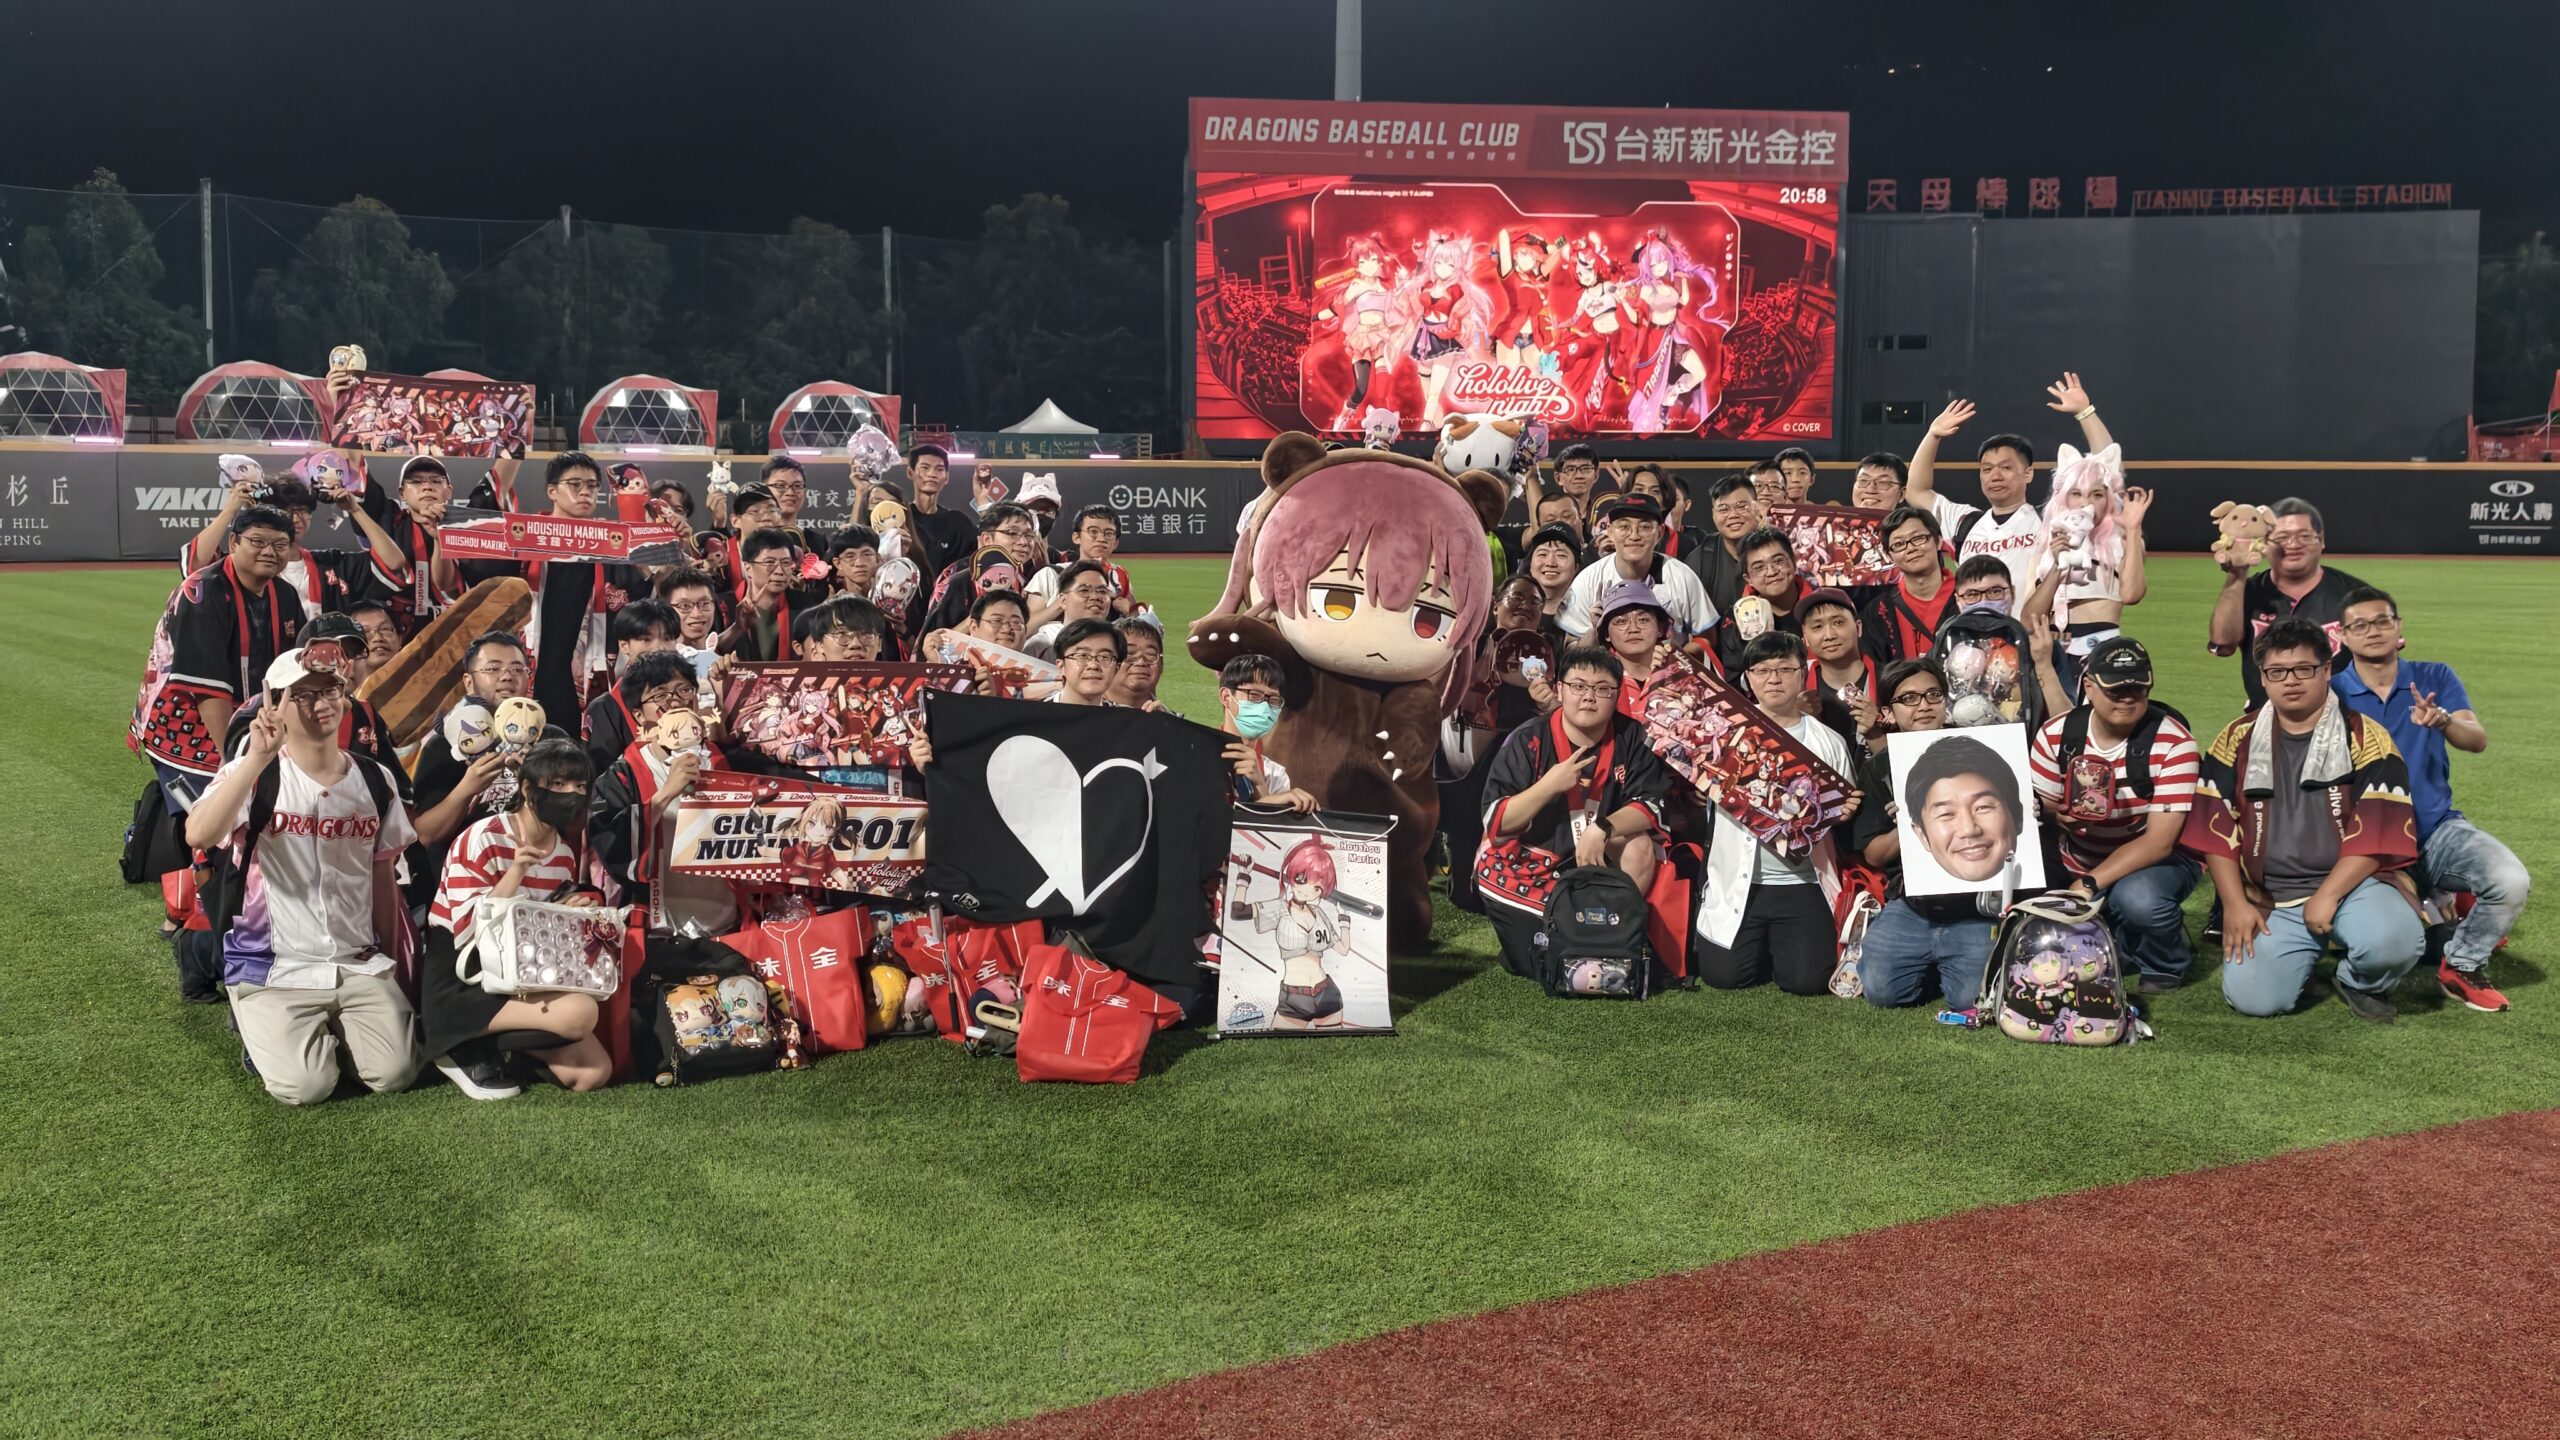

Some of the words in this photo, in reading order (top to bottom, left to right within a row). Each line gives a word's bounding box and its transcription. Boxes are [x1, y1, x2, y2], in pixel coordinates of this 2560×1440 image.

[1204, 116, 1320, 142] DRAGONS
[1328, 119, 1449, 146] BASEBALL
[1458, 122, 1521, 147] CLUB
[1614, 126, 1837, 166] 台新新光金控
[1779, 188, 1828, 204] 20:58
[2133, 189, 2214, 210] TIANMU
[2223, 186, 2340, 208] BASEBALL
[2355, 183, 2453, 205] STADIUM
[1454, 364, 1554, 395] hololive
[1488, 387, 1569, 416] night
[1791, 423, 1821, 433] COVER
[6, 475, 70, 507] 杉丘
[2470, 502, 2553, 521] 新光人壽
[12, 518, 49, 529] HILL
[159, 517, 200, 528] TAKE
[526, 521, 572, 538] HOUSHOU
[574, 526, 609, 541] MARINE
[0, 535, 42, 546] PING
[445, 535, 479, 549] HOUSHOU
[480, 540, 507, 552] MARINE
[1963, 533, 2037, 555] DRAGONS
[270, 811, 379, 841] DRAGONS
[2252, 811, 2264, 857] production
[1340, 841, 1381, 854] Houshou
[1347, 853, 1381, 865] Marine
[869, 863, 909, 878] hololive
[880, 876, 912, 892] night
[652, 880, 661, 924] AGONS
[1315, 929, 1331, 944] M
